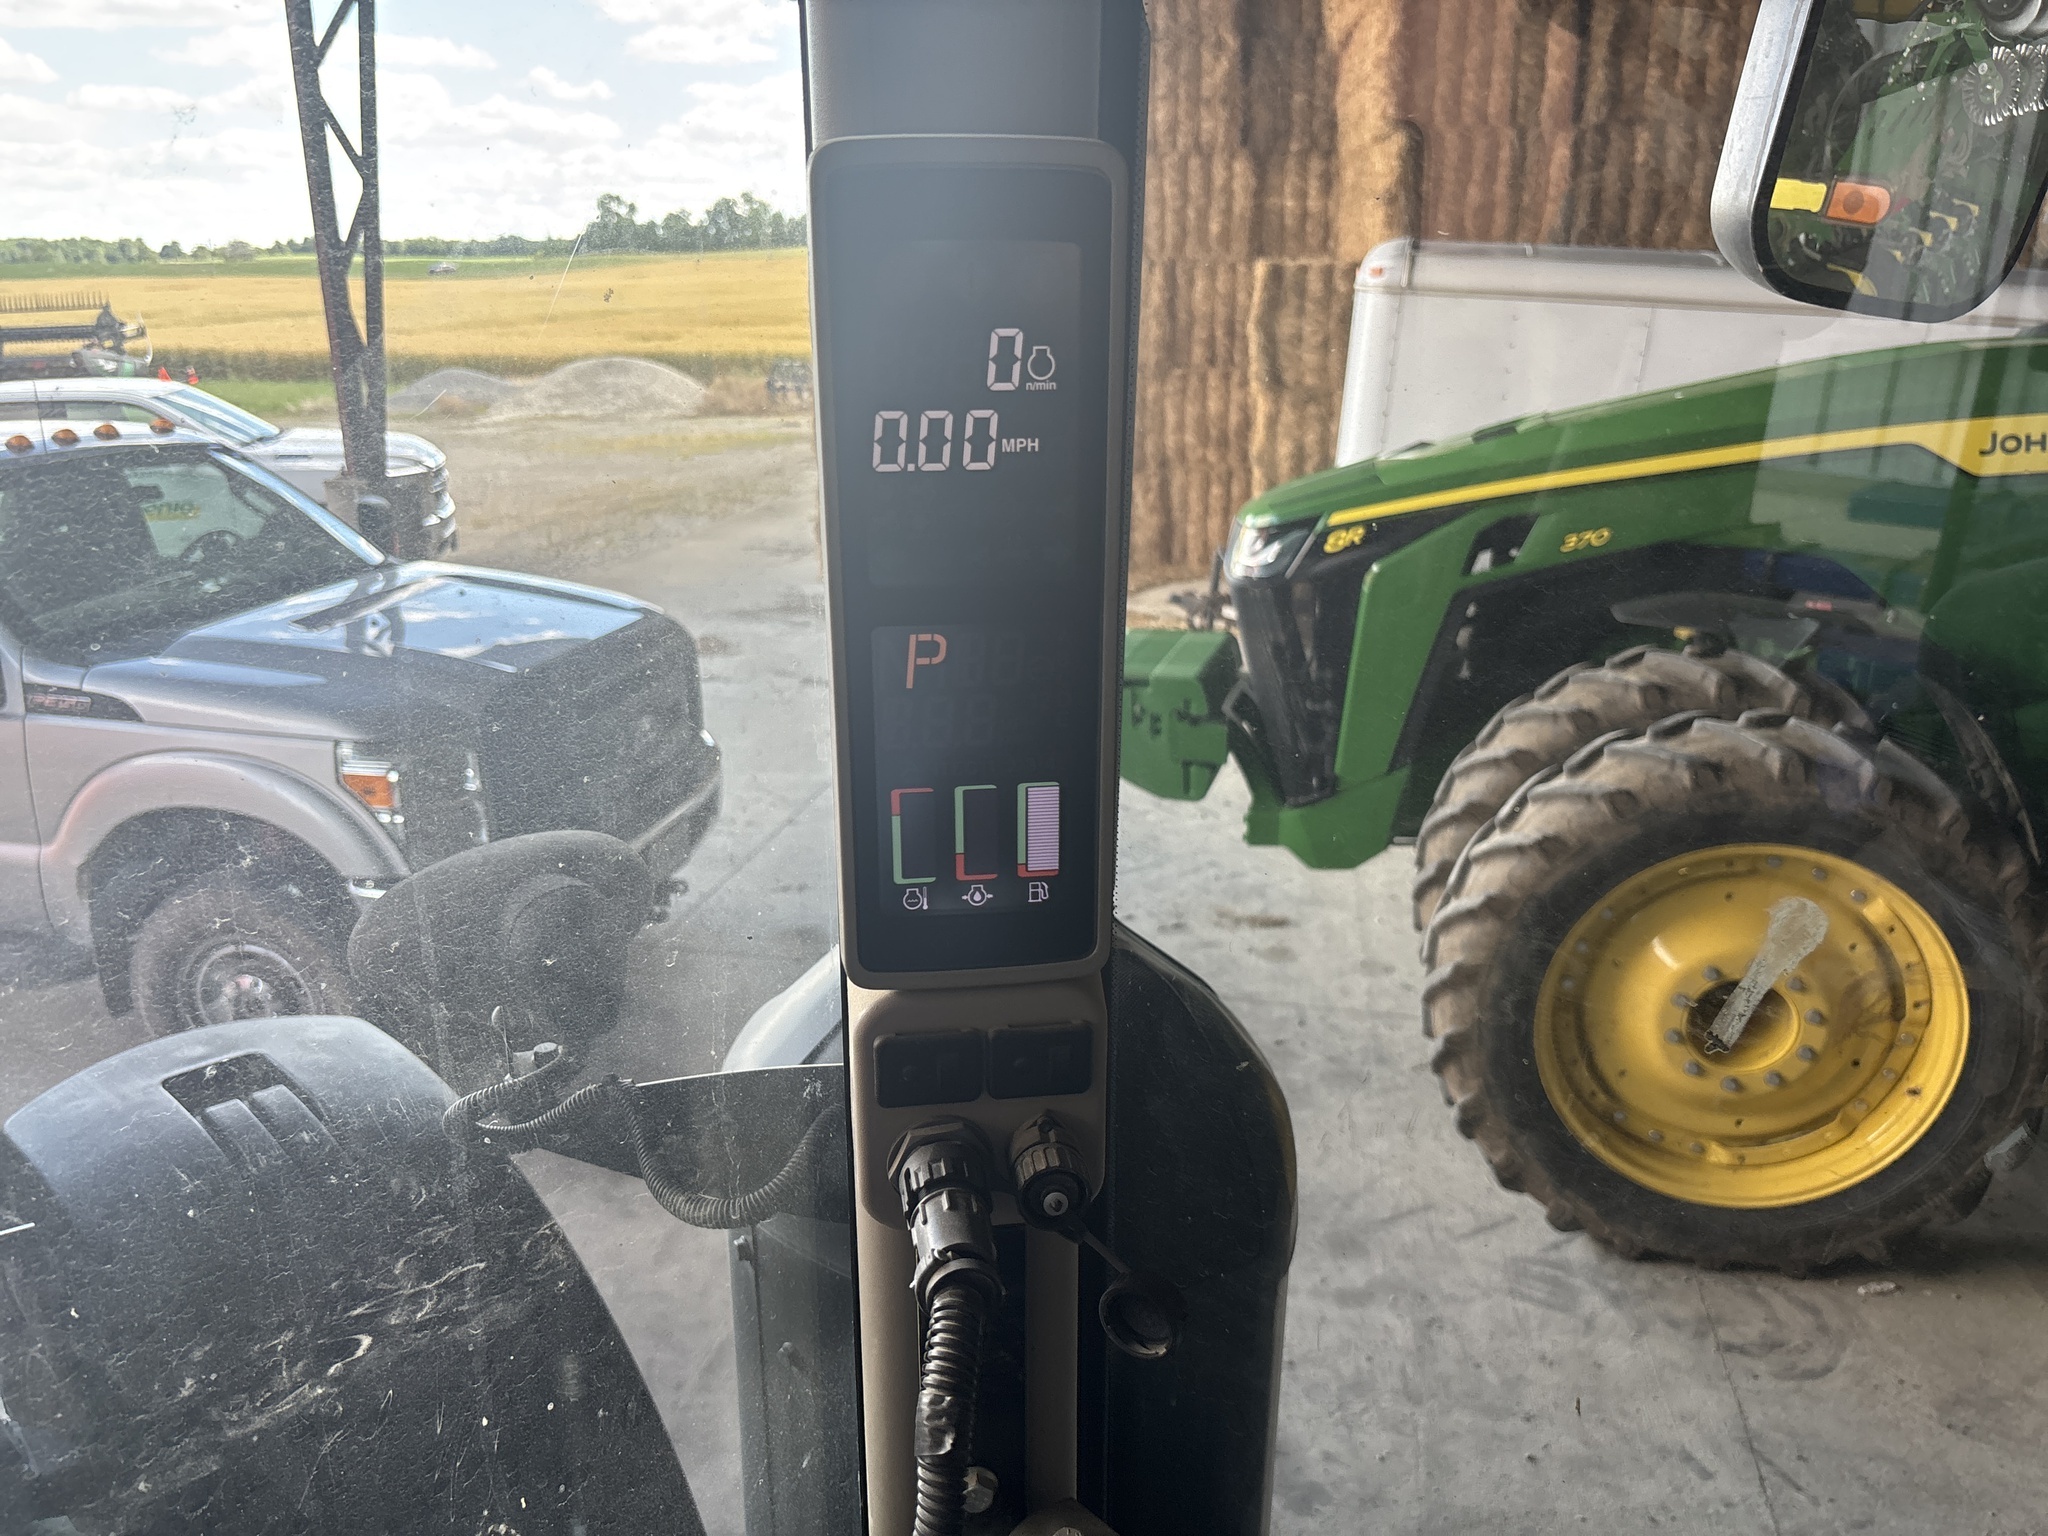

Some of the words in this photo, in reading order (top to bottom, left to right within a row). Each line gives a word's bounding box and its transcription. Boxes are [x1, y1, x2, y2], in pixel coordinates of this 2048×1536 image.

[986, 328, 1023, 391] 0
[1025, 380, 1057, 391] n/min
[872, 410, 999, 472] 0.00
[1002, 438, 1039, 453] MPH
[1323, 526, 1366, 554] 8R
[1560, 527, 1612, 553] 370
[905, 633, 948, 690] P
